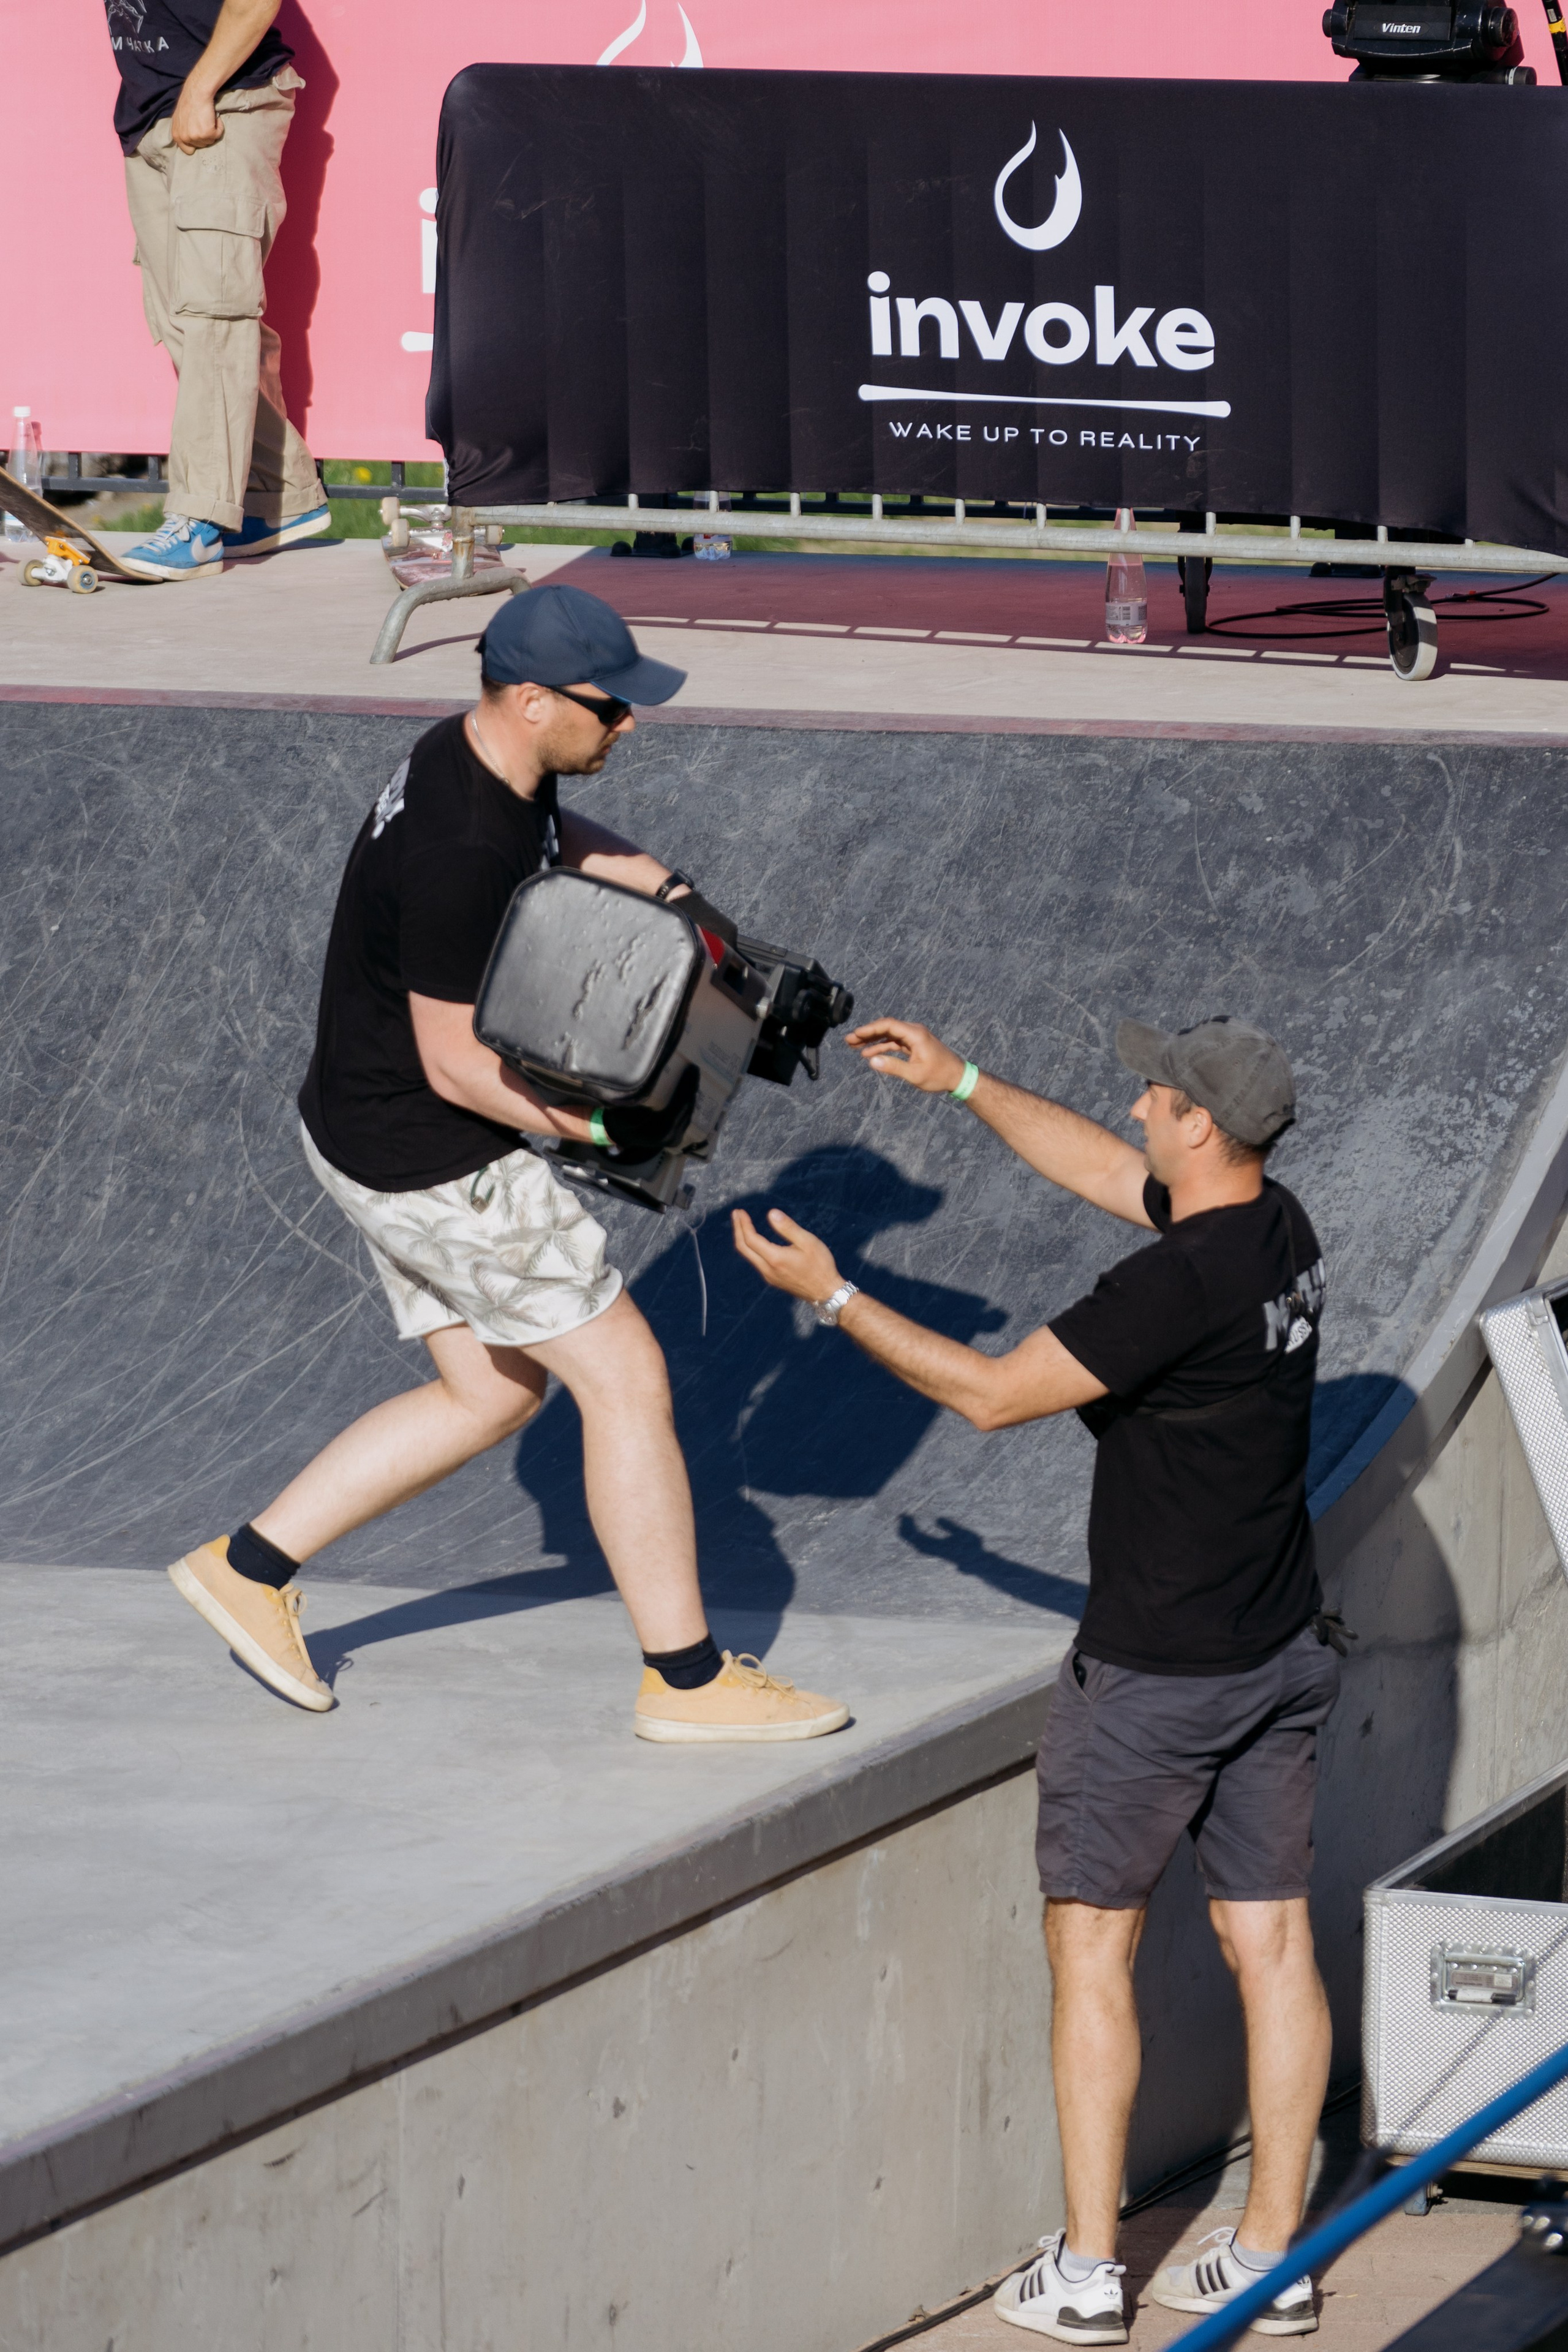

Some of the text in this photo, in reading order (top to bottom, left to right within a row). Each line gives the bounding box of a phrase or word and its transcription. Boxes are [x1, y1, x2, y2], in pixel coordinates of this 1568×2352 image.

[1382, 23, 1421, 33] Vinten
[867, 271, 1215, 371] invoke
[889, 421, 1200, 451] WAKE UP TO REALITY
